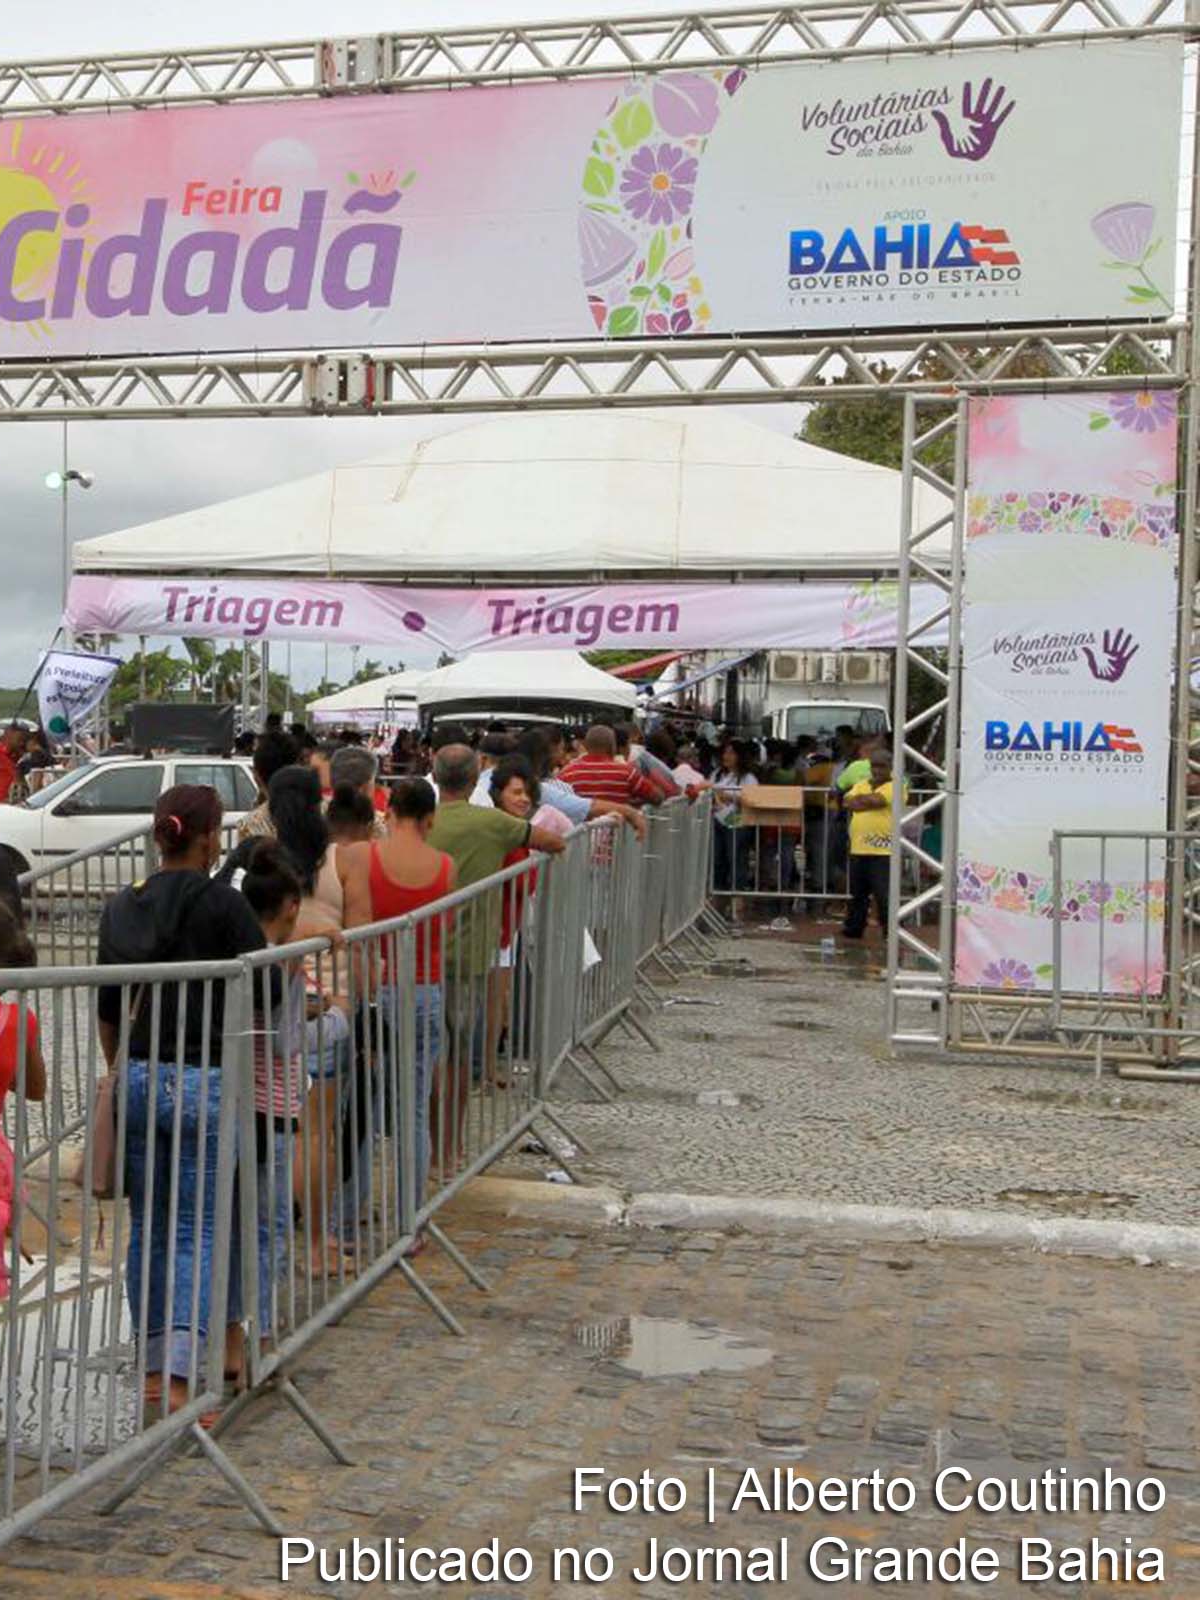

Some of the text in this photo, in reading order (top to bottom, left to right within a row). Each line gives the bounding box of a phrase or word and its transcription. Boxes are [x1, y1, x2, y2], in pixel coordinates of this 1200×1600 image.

[800, 86, 952, 131] Voluntárias
[827, 113, 928, 156] Sociais
[181, 178, 282, 216] Feira
[883, 209, 926, 221] APOIO
[789, 221, 981, 275] BAHIA
[788, 267, 1021, 290] GOVERNO DO ESTADO
[163, 586, 344, 636] Triagem
[488, 597, 679, 646] Triagem
[993, 632, 1096, 655] Voluntárias
[1011, 649, 1078, 673] Sociais
[985, 720, 1116, 751] BAHIA
[984, 752, 1144, 763] GOVERNO DO ESTADO
